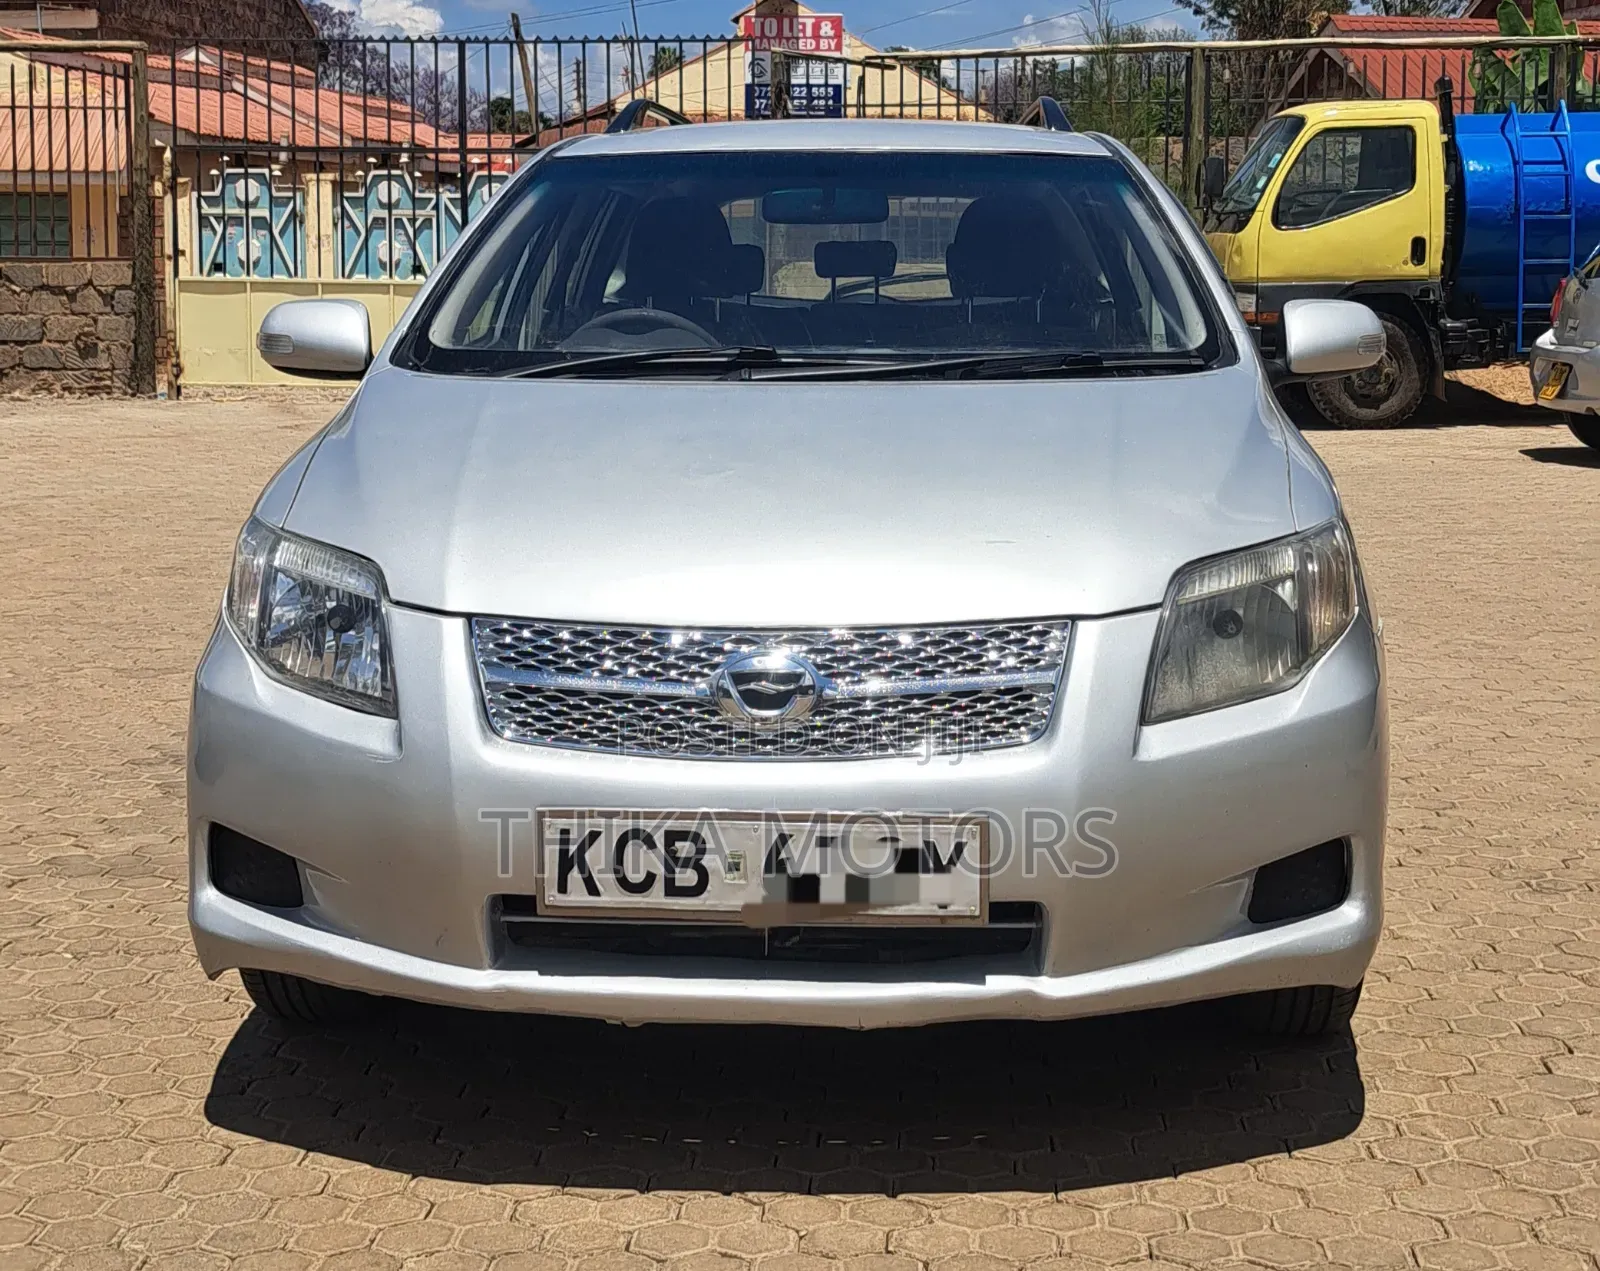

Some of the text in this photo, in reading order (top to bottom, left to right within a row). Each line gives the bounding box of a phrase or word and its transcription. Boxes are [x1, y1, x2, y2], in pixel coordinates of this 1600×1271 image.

[751, 18, 835, 37] TO LET &
[748, 39, 838, 50] MANAGED BY
[556, 826, 710, 899] KCB
